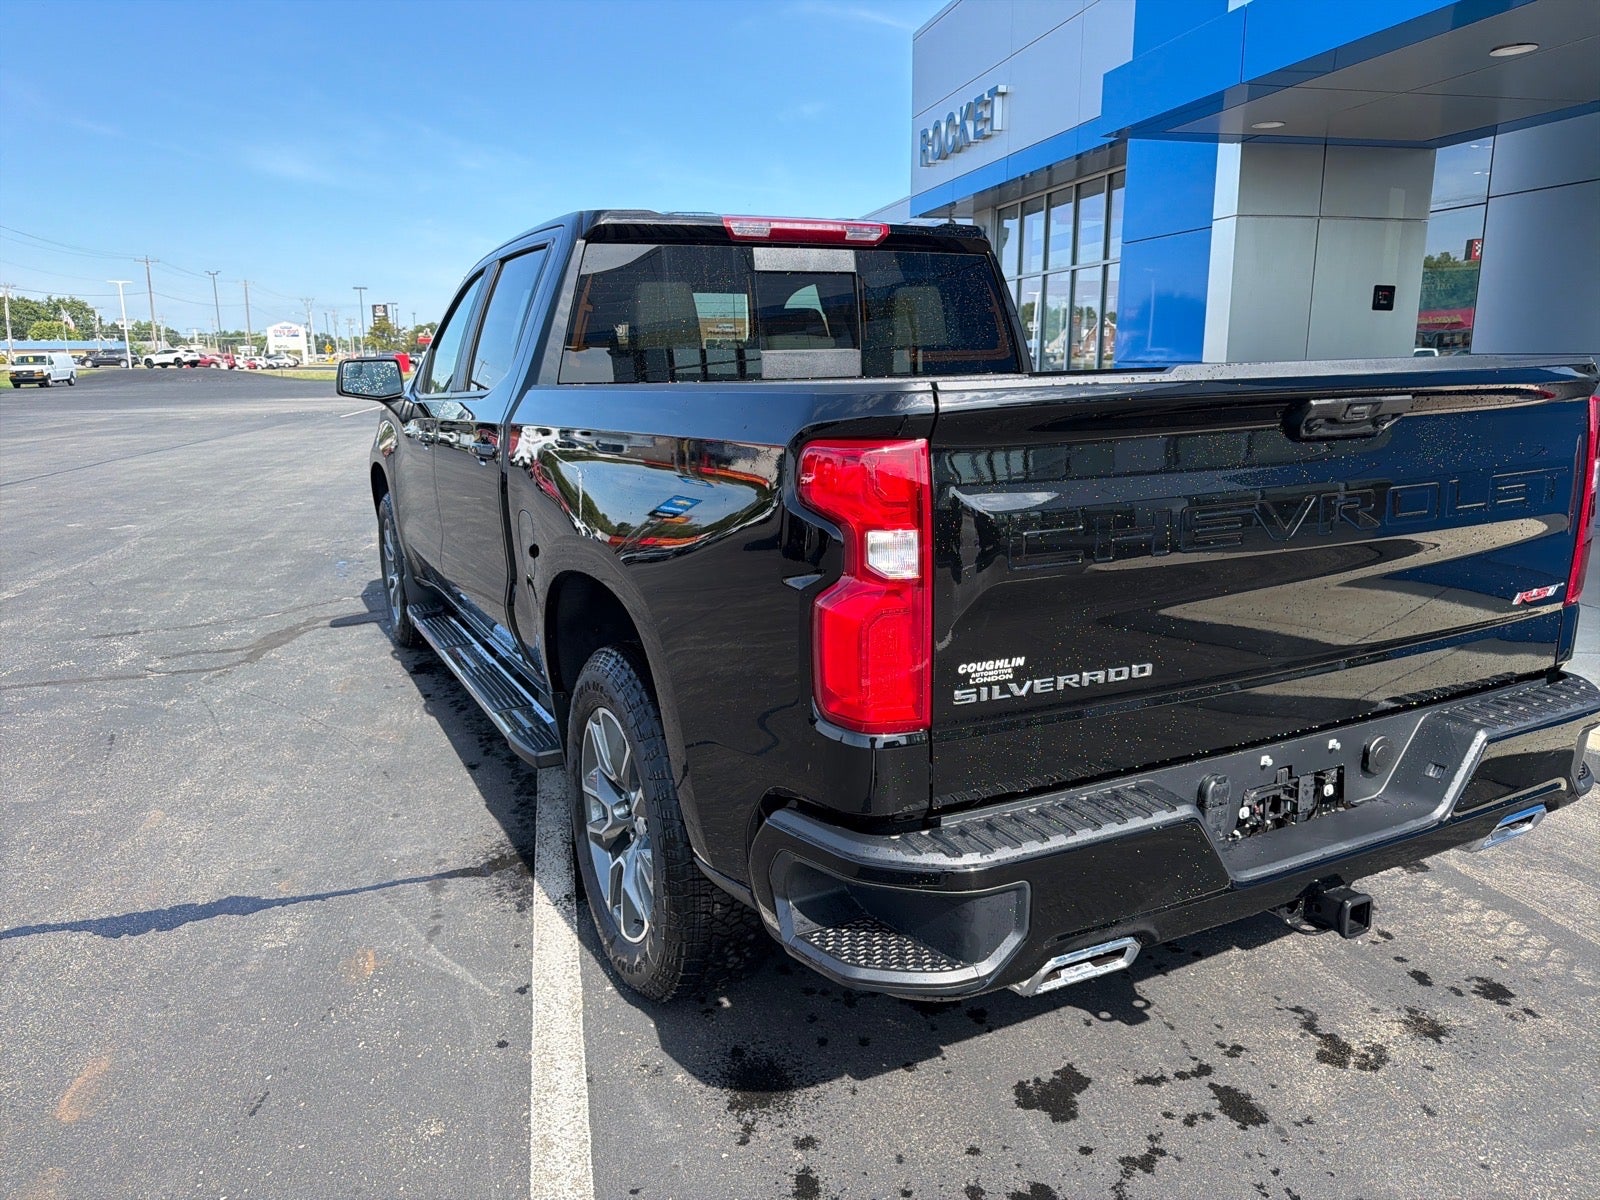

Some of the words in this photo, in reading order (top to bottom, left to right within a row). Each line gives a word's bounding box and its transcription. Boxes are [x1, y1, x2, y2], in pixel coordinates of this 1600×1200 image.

[920, 84, 1008, 168] ROCKET
[1007, 466, 1568, 571] CHEVROLET
[957, 656, 1026, 675] COUGHLIN
[969, 673, 1014, 685] LONDON
[970, 667, 1013, 679] AUTOMOTIVE
[952, 662, 1154, 706] SILVERADO
